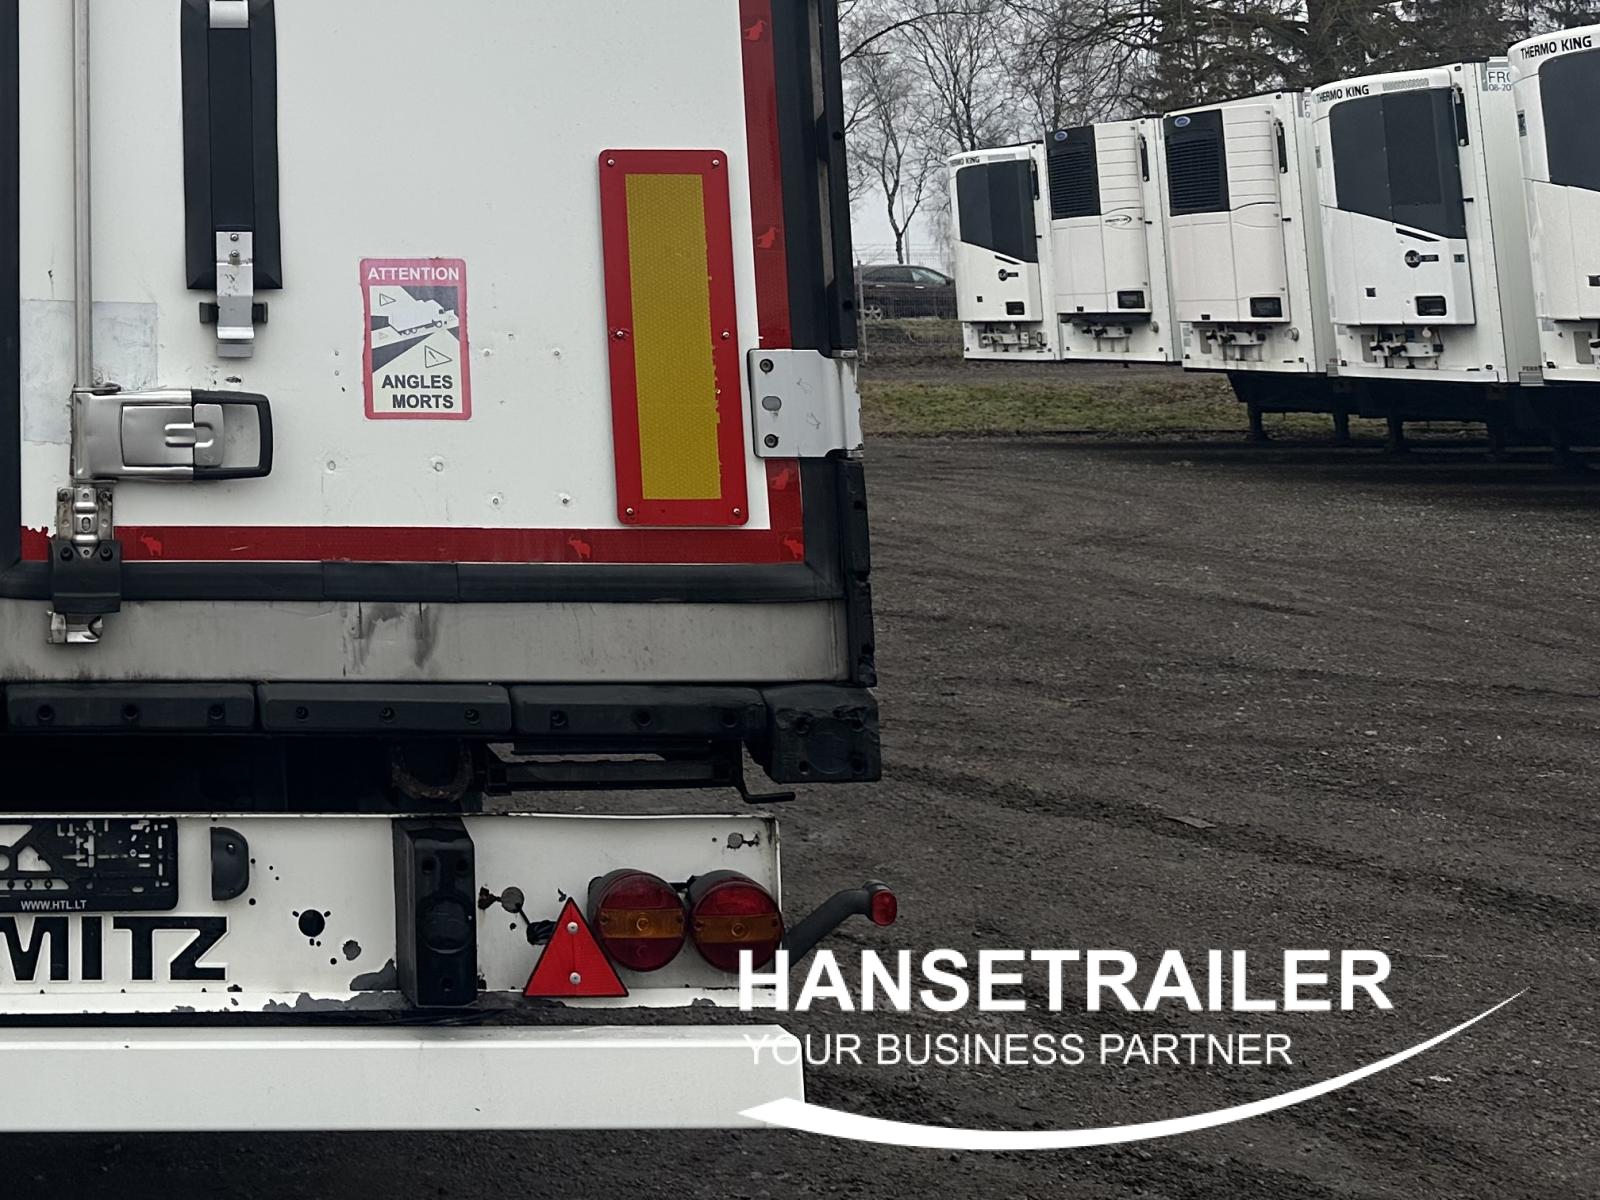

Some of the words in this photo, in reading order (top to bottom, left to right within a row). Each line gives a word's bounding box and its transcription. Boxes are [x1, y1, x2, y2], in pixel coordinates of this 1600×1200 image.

[1520, 41, 1557, 60] THERMO
[1561, 35, 1593, 52] KING
[1345, 84, 1370, 98] KING
[1488, 83, 1512, 92] 08-20
[367, 267, 460, 281] ATTENTION
[381, 374, 453, 390] ANGLES
[391, 394, 454, 409] MORTS
[19, 899, 88, 911] WWW.HTL.LT
